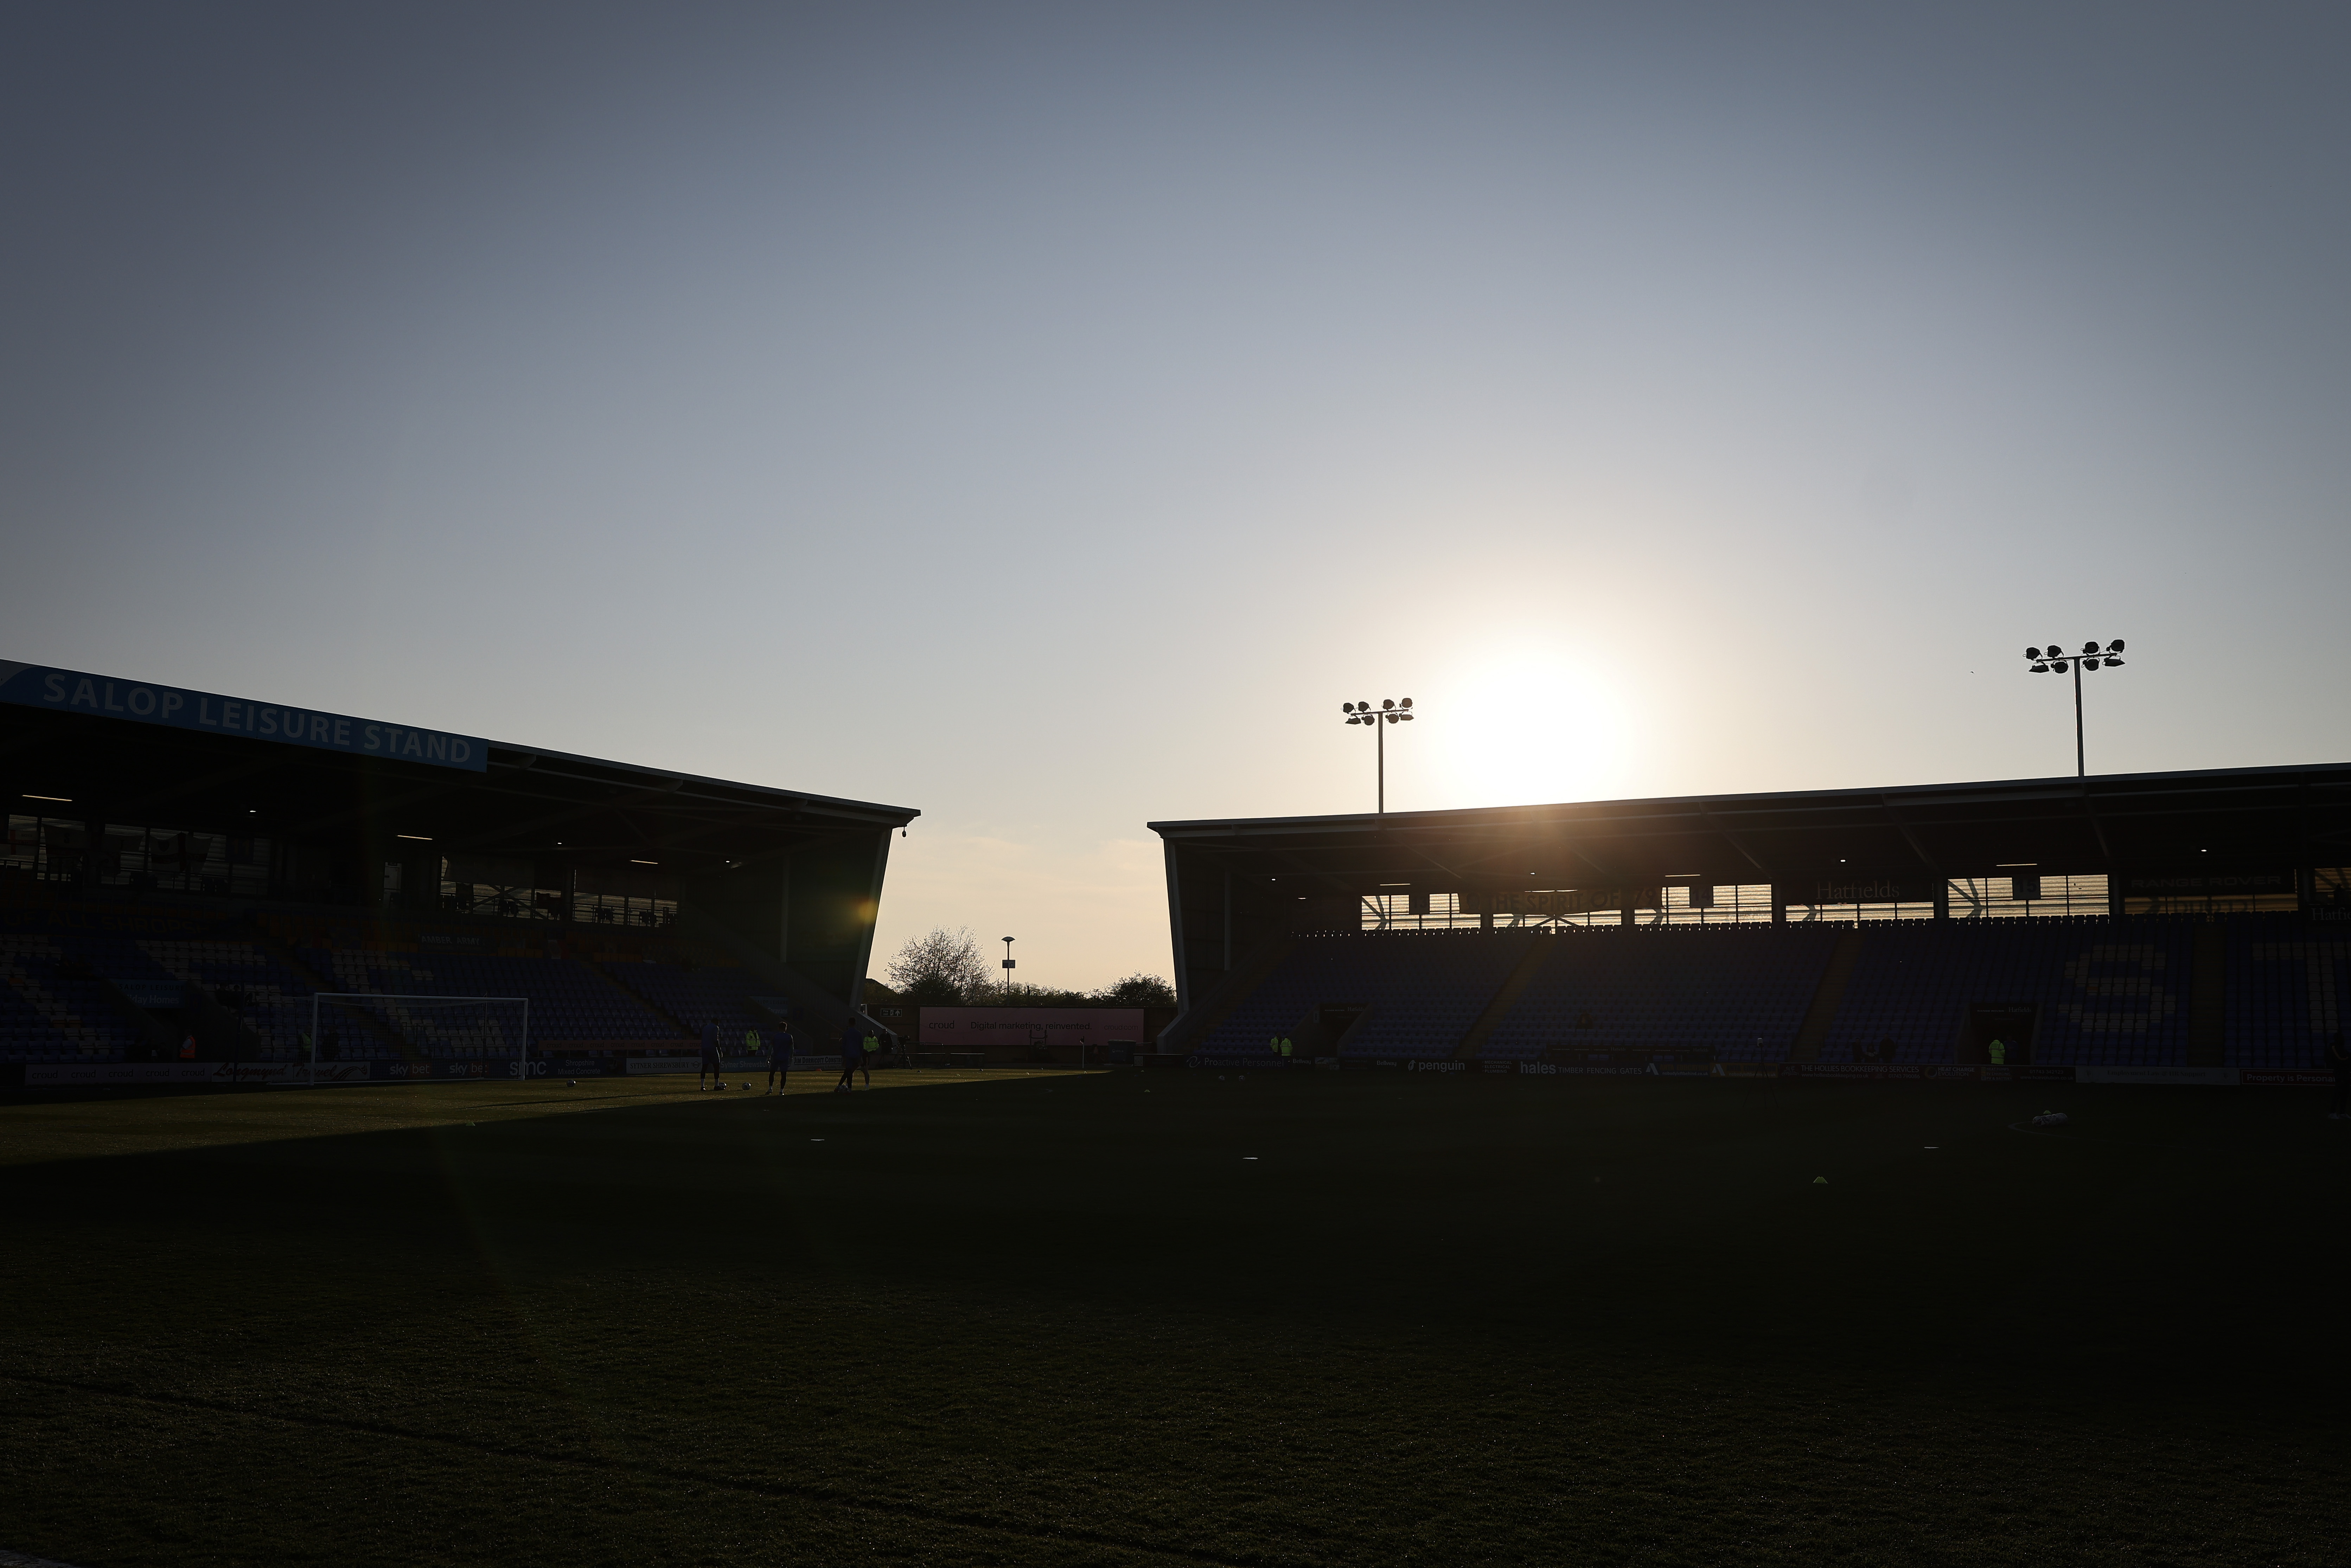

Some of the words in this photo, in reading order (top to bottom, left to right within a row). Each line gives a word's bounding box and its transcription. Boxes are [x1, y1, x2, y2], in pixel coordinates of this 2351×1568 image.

[43, 673, 183, 718] SALOP
[199, 698, 350, 746] LEISURE
[364, 725, 470, 762] STAND
[2017, 879, 2037, 893] 15
[2131, 878, 2203, 888] RANGE
[2209, 875, 2282, 887] ROVER
[1816, 880, 1900, 900] Hatfields
[47, 911, 95, 929] ALL
[422, 935, 453, 944] AMBER
[457, 937, 479, 946] ARMY
[149, 995, 179, 1004] Homes
[929, 1020, 954, 1029] croud
[970, 1021, 996, 1031] Digital
[999, 1022, 1043, 1031] marketing,
[1046, 1022, 1092, 1030] reinvented.
[449, 1062, 468, 1075] sky
[566, 1060, 595, 1068] Shropshire
[1204, 1057, 1240, 1067] Proactive
[1242, 1058, 1284, 1067] Personnel
[1419, 1060, 1465, 1074] penguin
[1520, 1061, 1556, 1074] hales
[32, 1070, 58, 1079] croud
[71, 1069, 96, 1078] croud
[109, 1069, 133, 1077] croud
[146, 1069, 170, 1077] croud
[181, 1068, 205, 1076] croud
[389, 1063, 409, 1076] sky
[412, 1064, 429, 1074] bet
[2247, 1074, 2285, 1083] Property
